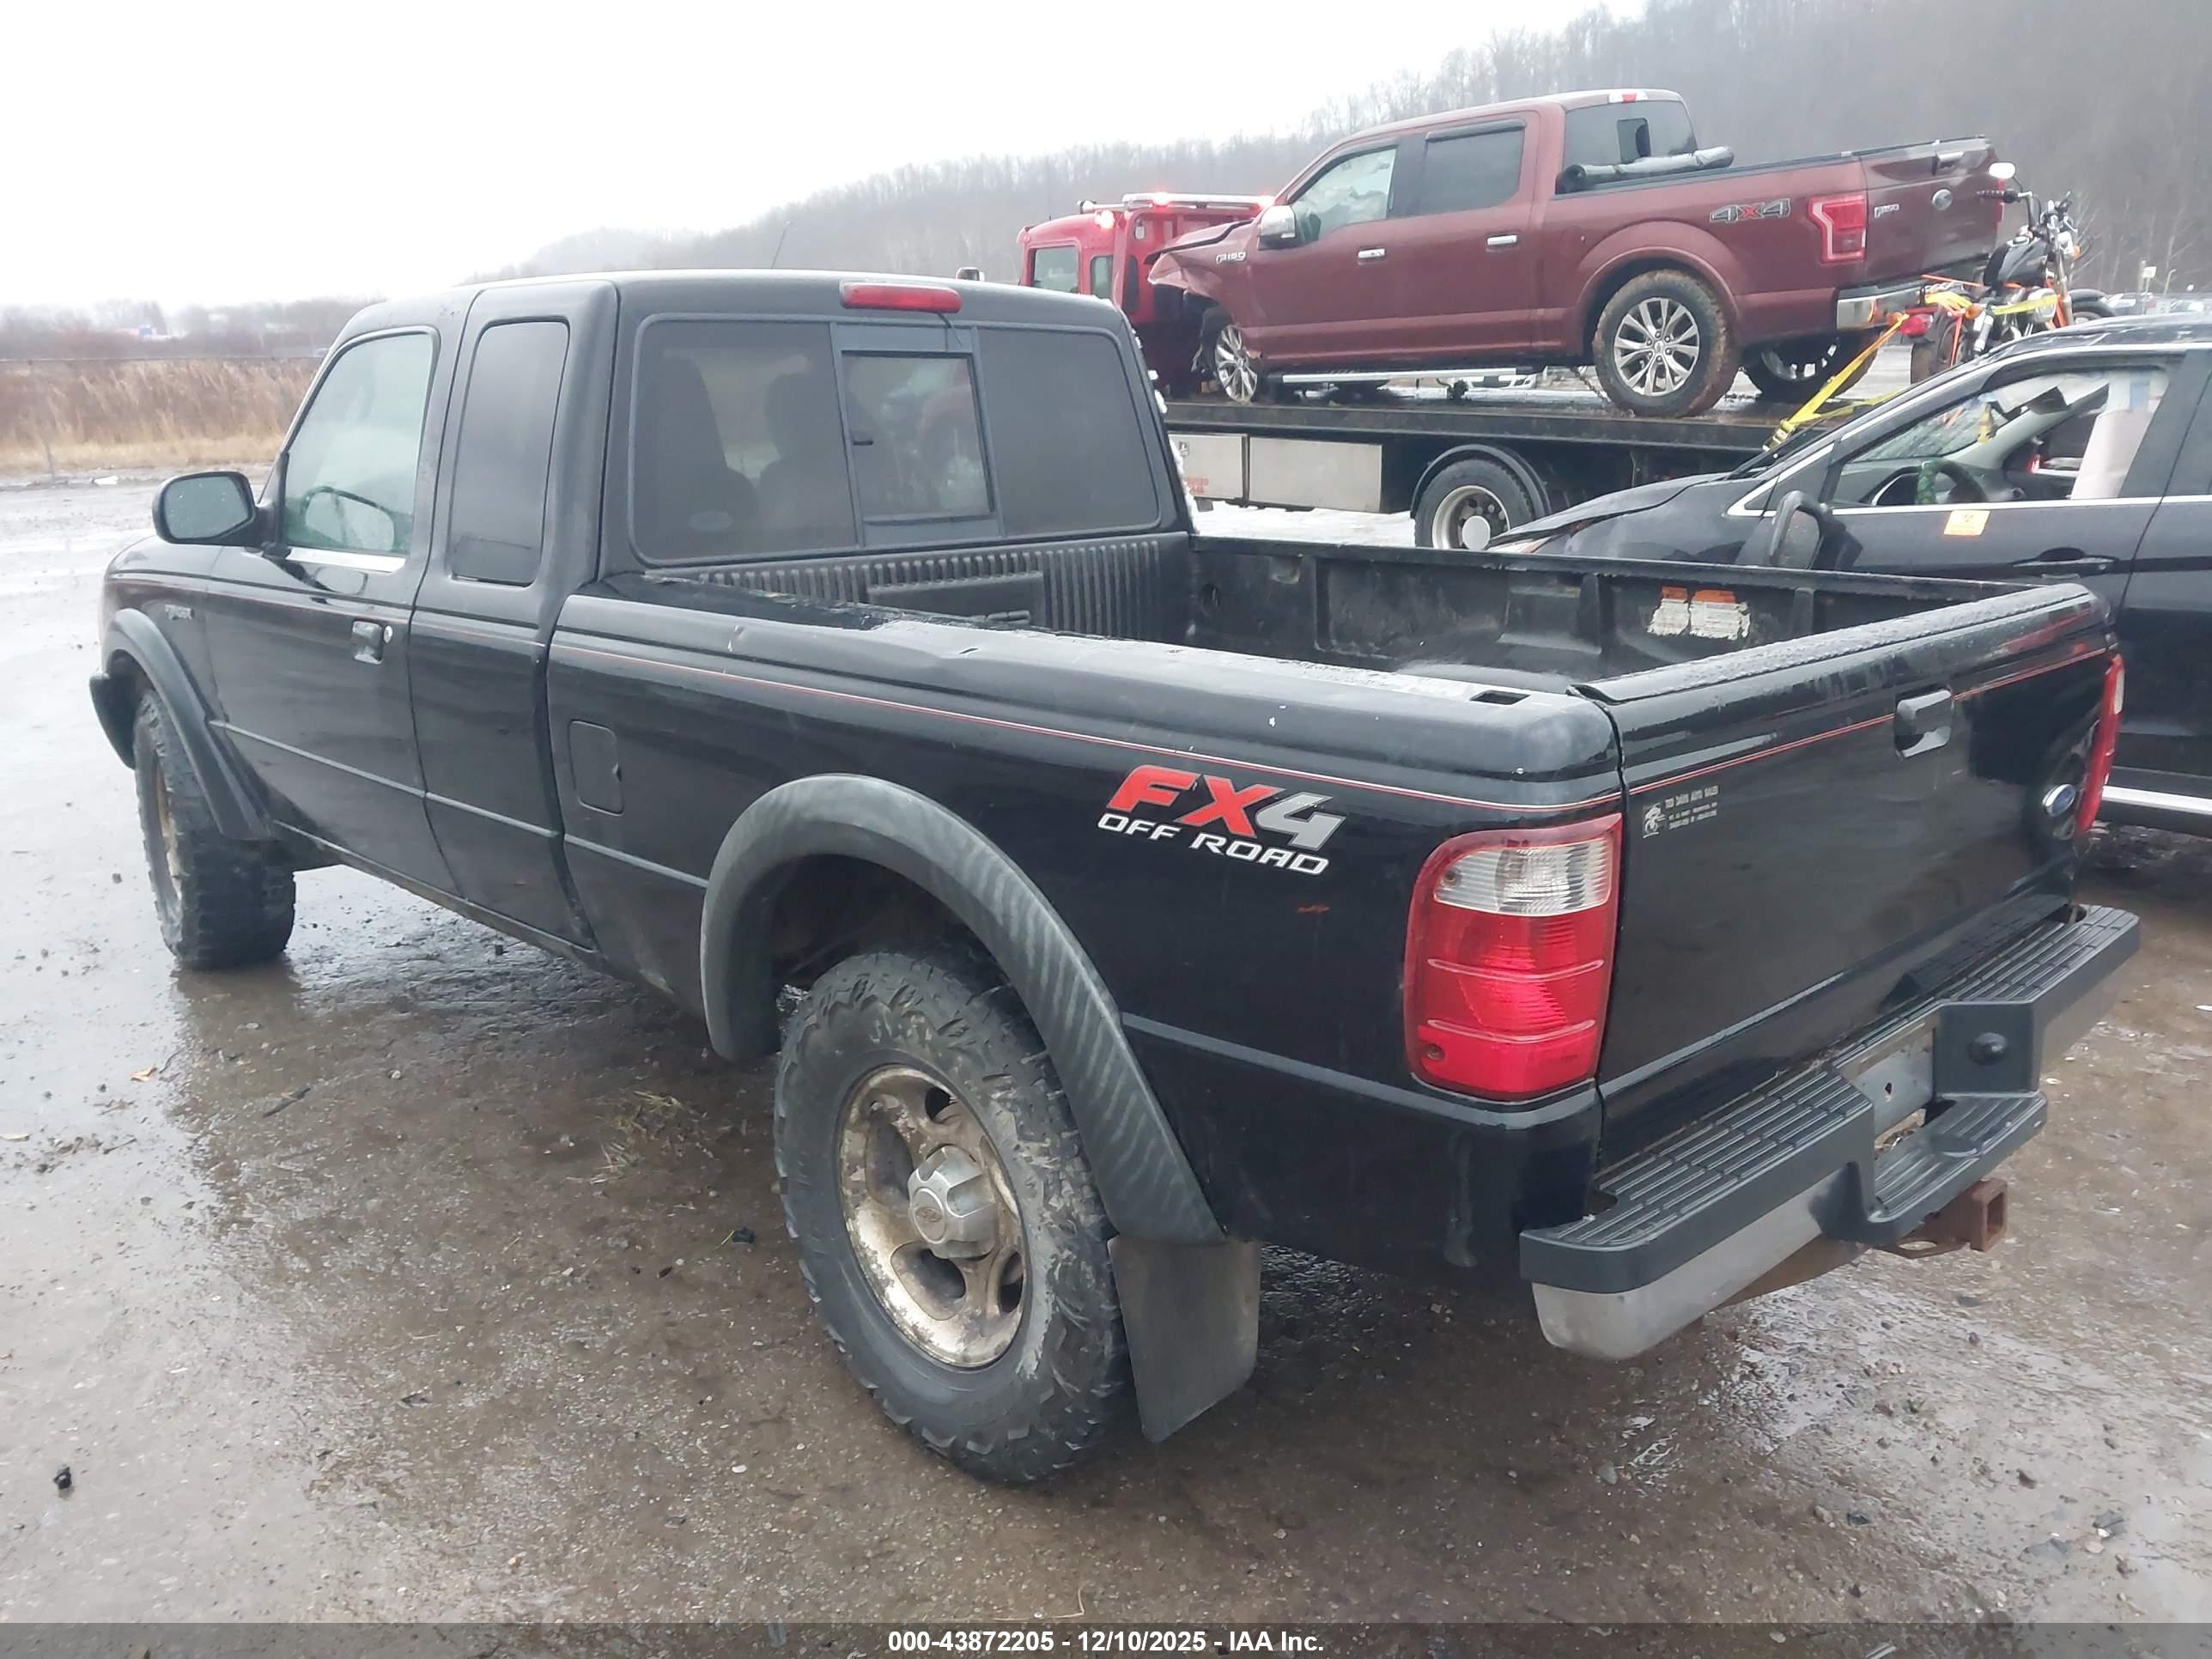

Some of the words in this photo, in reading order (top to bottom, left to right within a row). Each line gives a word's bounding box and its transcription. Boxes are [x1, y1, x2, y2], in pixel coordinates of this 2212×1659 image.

[1097, 812, 1182, 842] OFF
[1189, 832, 1330, 876] ROAD
[1106, 763, 1346, 851] FX4
